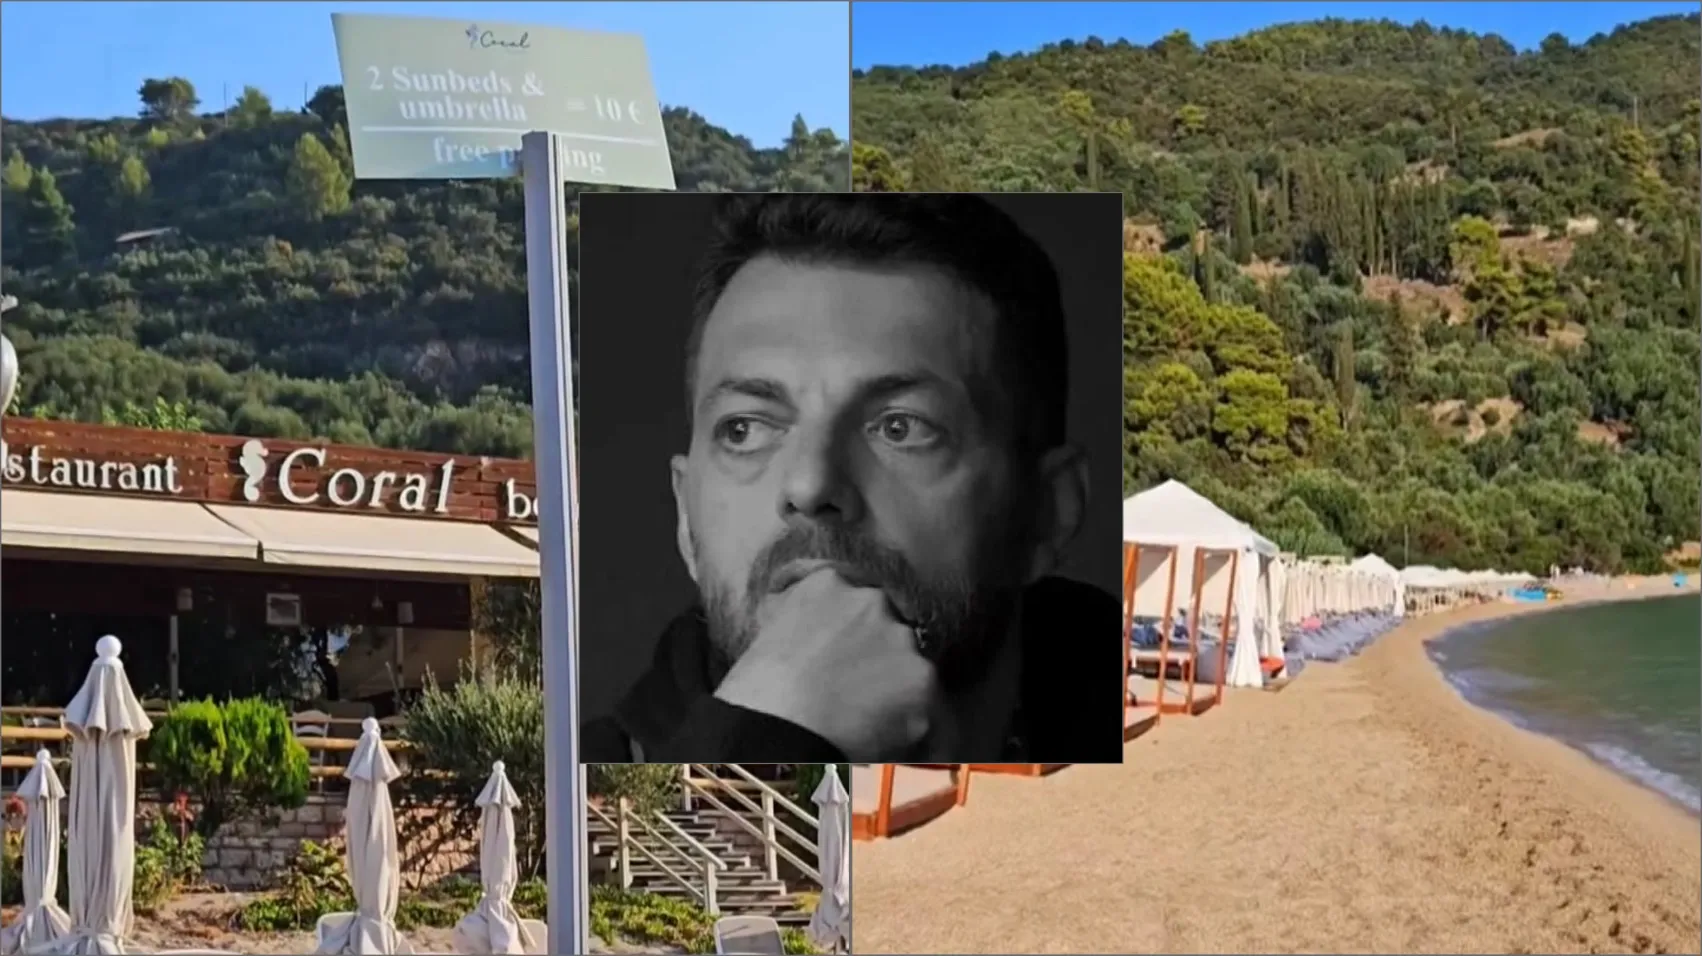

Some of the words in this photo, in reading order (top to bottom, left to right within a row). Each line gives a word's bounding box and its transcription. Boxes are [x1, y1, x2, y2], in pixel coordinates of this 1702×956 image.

[480, 30, 530, 49] Coral
[367, 65, 384, 92] 2
[392, 67, 512, 95] Sunbeds
[521, 72, 545, 97] &
[400, 96, 527, 122] umbrella
[433, 136, 489, 164] free
[499, 142, 605, 176] ping
[278, 447, 456, 513] Coral
[507, 478, 539, 519] b
